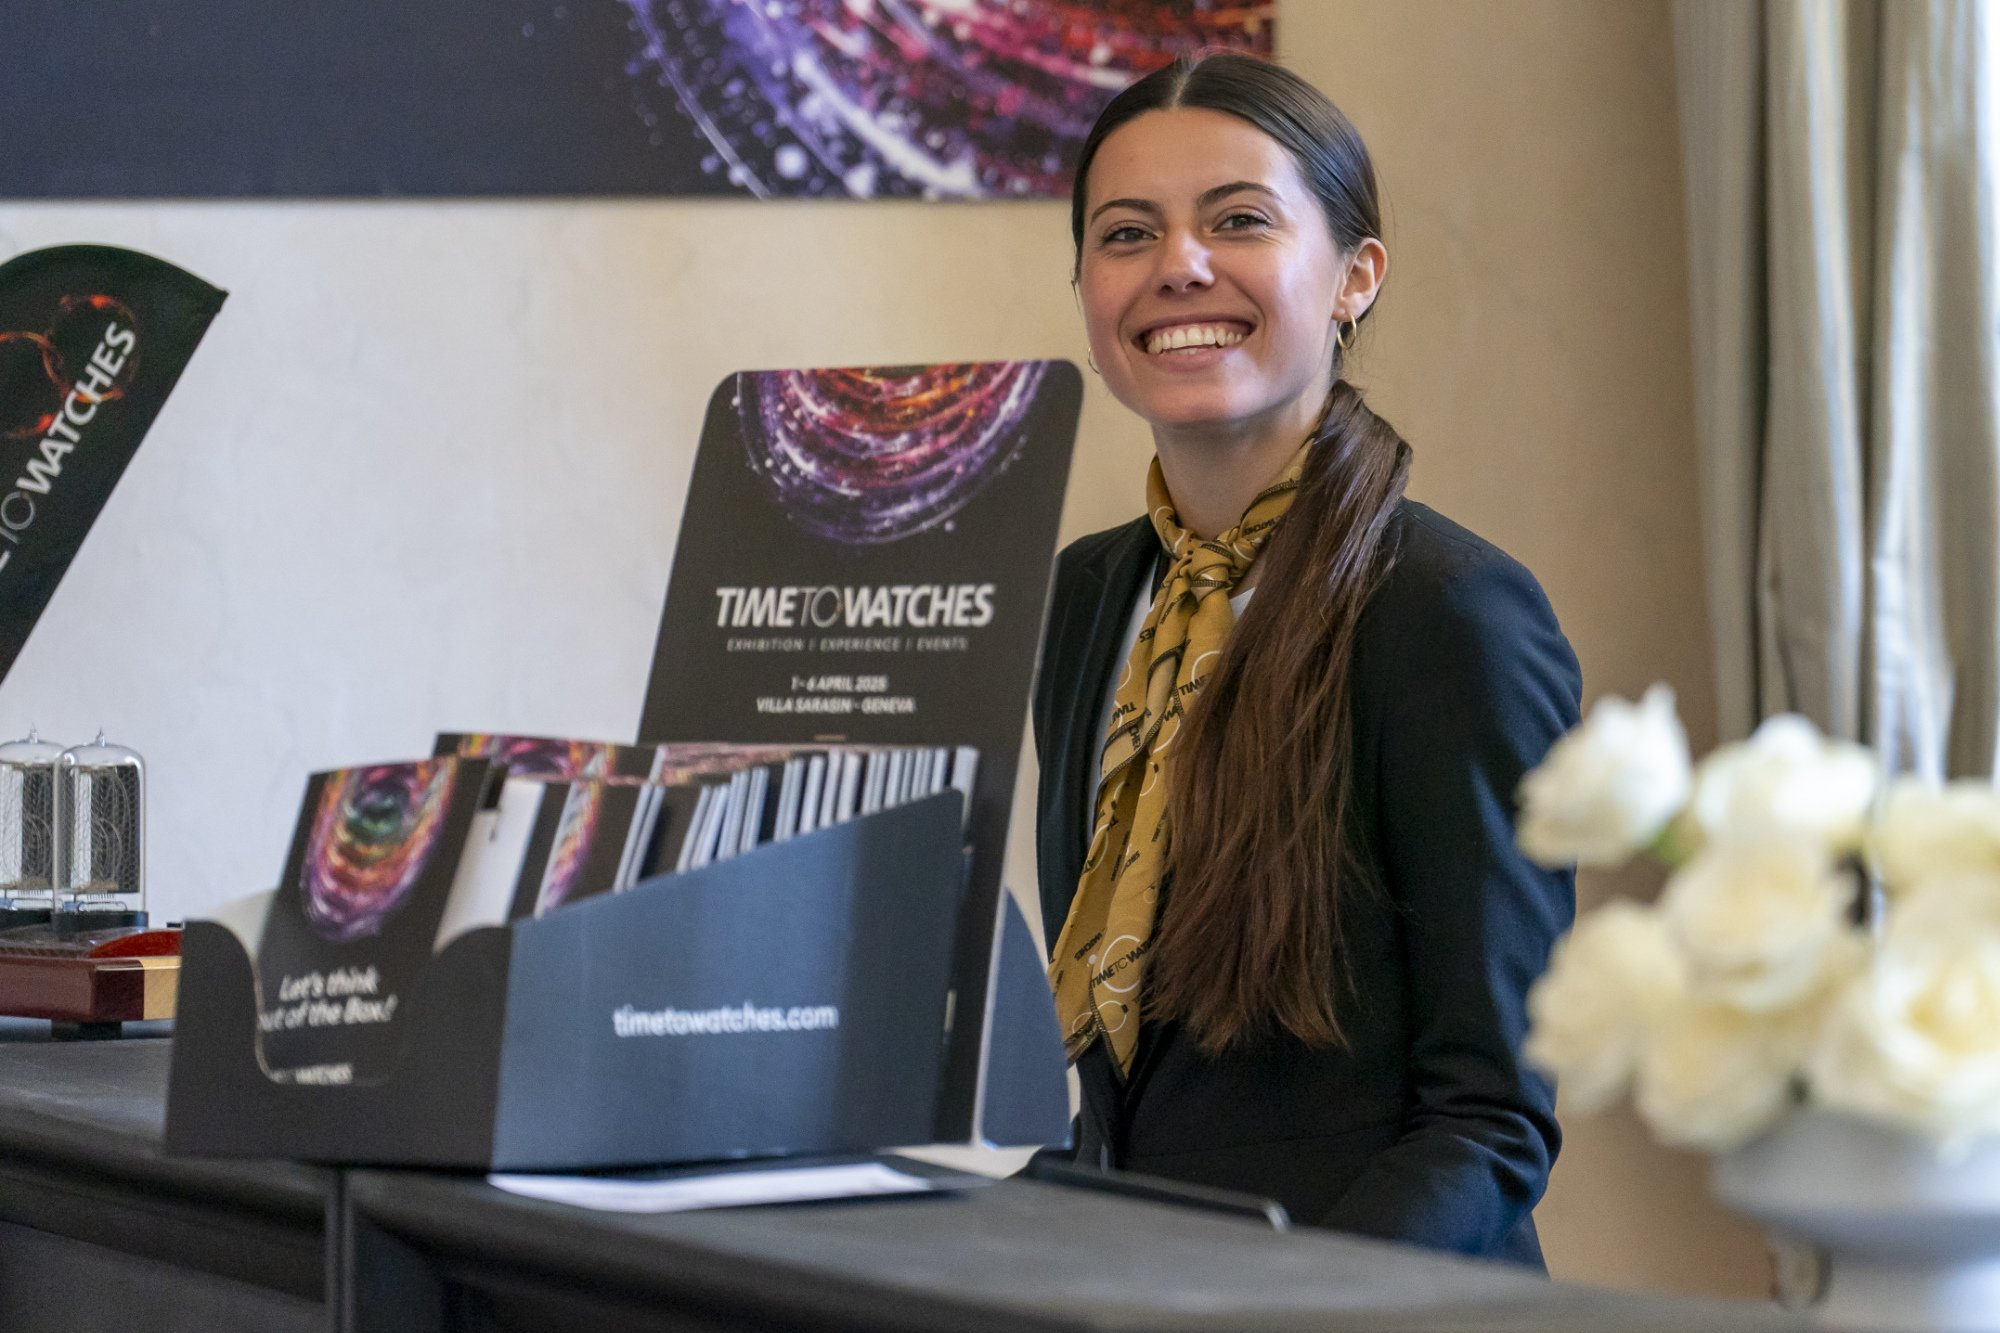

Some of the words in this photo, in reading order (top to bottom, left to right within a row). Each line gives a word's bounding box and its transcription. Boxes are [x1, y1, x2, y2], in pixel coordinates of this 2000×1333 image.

[816, 675, 854, 692] APRIL
[756, 697, 793, 712] VILLA
[794, 697, 852, 713] SARASIN
[861, 697, 915, 714] GENEVA
[279, 974, 324, 1002] Let's
[326, 964, 379, 997] think
[284, 998, 309, 1029] of
[308, 999, 343, 1028] the
[343, 993, 399, 1025] Box!
[612, 1000, 839, 1038] timetowatches.com
